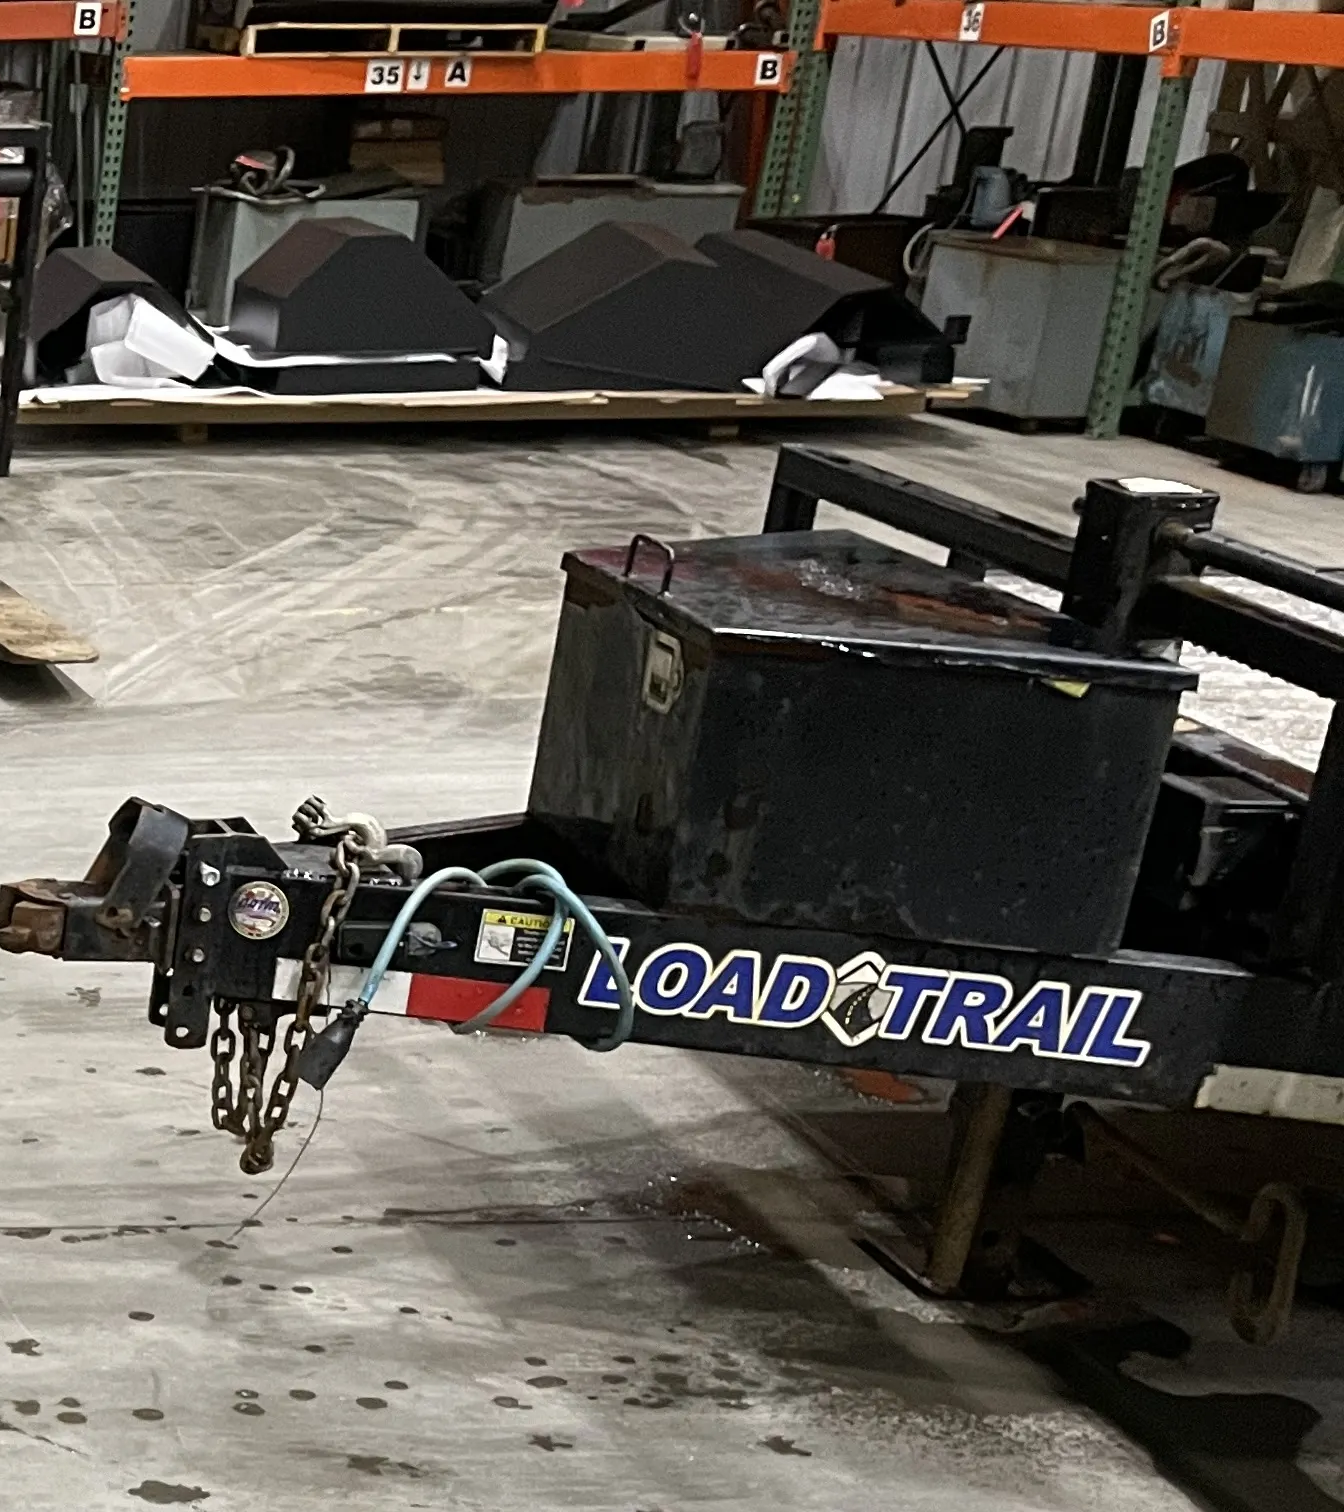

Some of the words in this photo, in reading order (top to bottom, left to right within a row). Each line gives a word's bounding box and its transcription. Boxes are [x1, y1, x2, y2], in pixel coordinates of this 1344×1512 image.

[79, 9, 96, 29] B
[1153, 20, 1166, 46] B
[370, 66, 400, 86] 35
[447, 61, 466, 82] A
[760, 60, 778, 80] B
[510, 914, 556, 930] CAUTIO
[578, 936, 837, 1030] LOAD
[878, 964, 1151, 1068] TRAIL
